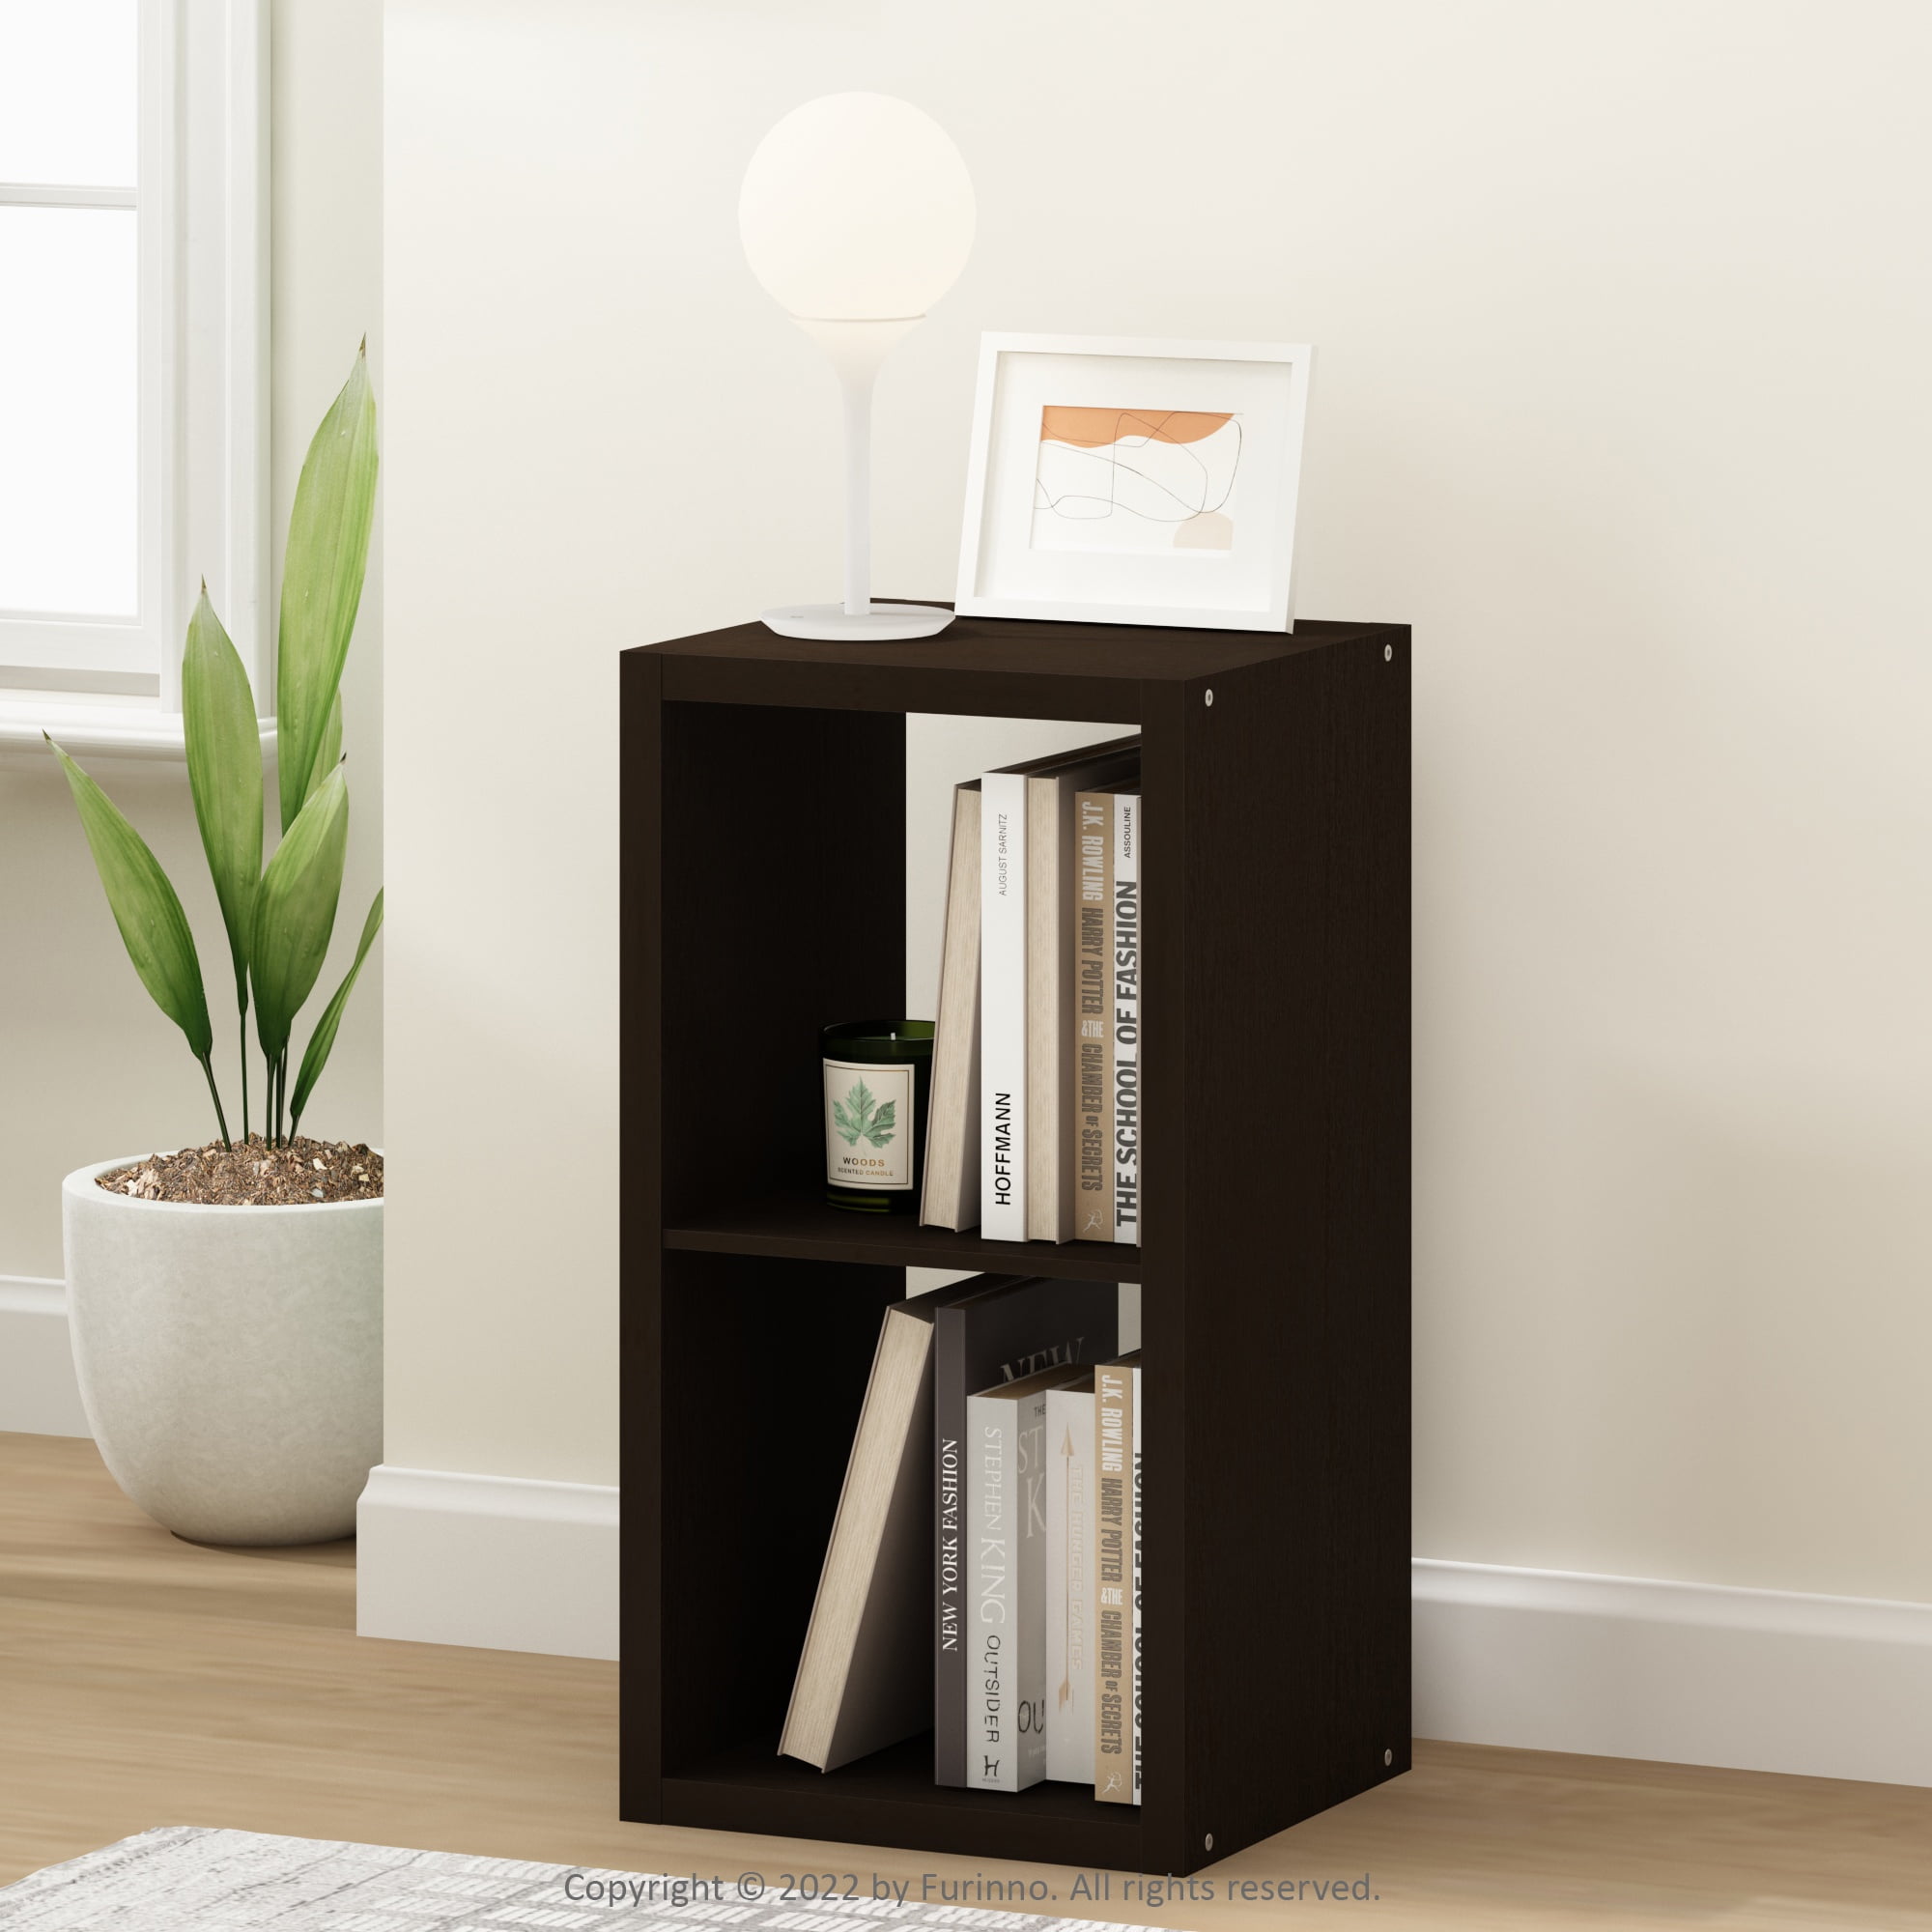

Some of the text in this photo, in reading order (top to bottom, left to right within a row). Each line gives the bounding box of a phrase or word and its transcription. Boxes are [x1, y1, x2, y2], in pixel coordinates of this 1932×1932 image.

[1081, 801, 1104, 831] J.K.
[998, 813, 1008, 896] AUGUST SARNITZ
[1081, 835, 1104, 901] ROWLING
[1081, 907, 1104, 957] HARRY
[1081, 960, 1104, 1014] POTTER
[1081, 1043, 1104, 1113] CHAMBER
[1116, 880, 1137, 1228] THE SCHOOL OF FASHION
[843, 1156, 885, 1167] WOODS
[994, 1093, 1011, 1206] HOFFMANN
[1081, 1128, 1104, 1192] SECRETS
[1100, 1375, 1123, 1404] J.K.
[1100, 1407, 1123, 1473] ROWLING
[1100, 1477, 1123, 1527] HARRY
[942, 1438, 958, 1652] NEW YORK FASHION
[1070, 1466, 1084, 1670] THE HUNGER GAMES
[1100, 1528, 1123, 1582] POTTER
[980, 1426, 1007, 1744] STEPHEN KING OUTSIDER
[1100, 1609, 1123, 1678] CHAMBER
[1100, 1693, 1123, 1755] SECRETS
